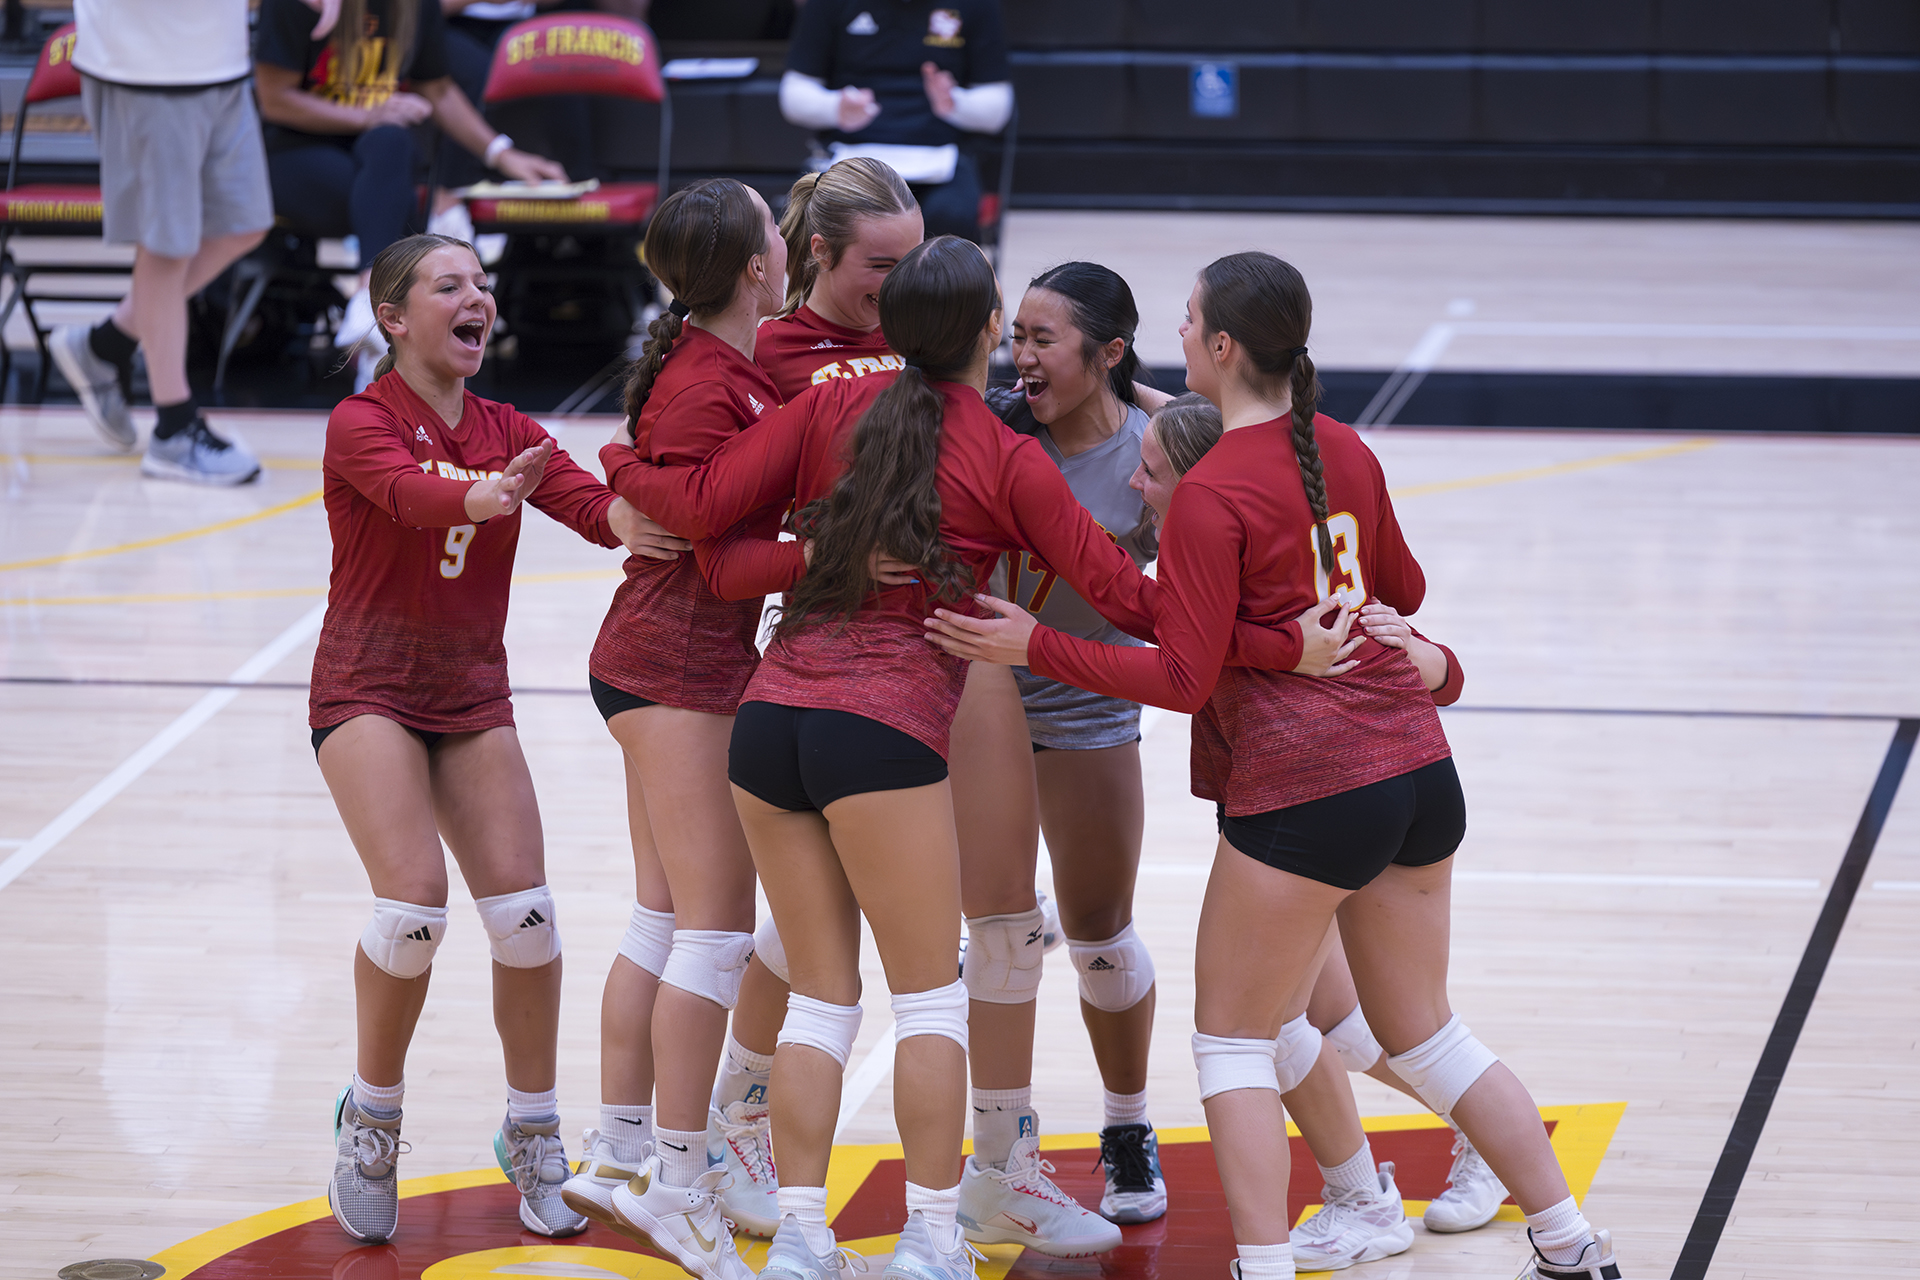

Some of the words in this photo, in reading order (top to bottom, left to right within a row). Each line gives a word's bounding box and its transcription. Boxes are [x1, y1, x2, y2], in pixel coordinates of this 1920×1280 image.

[506, 30, 544, 66] ST.
[546, 25, 645, 66] FRANCIS
[439, 523, 477, 579] 9
[1310, 511, 1367, 612] 13
[1006, 550, 1059, 614] 17
